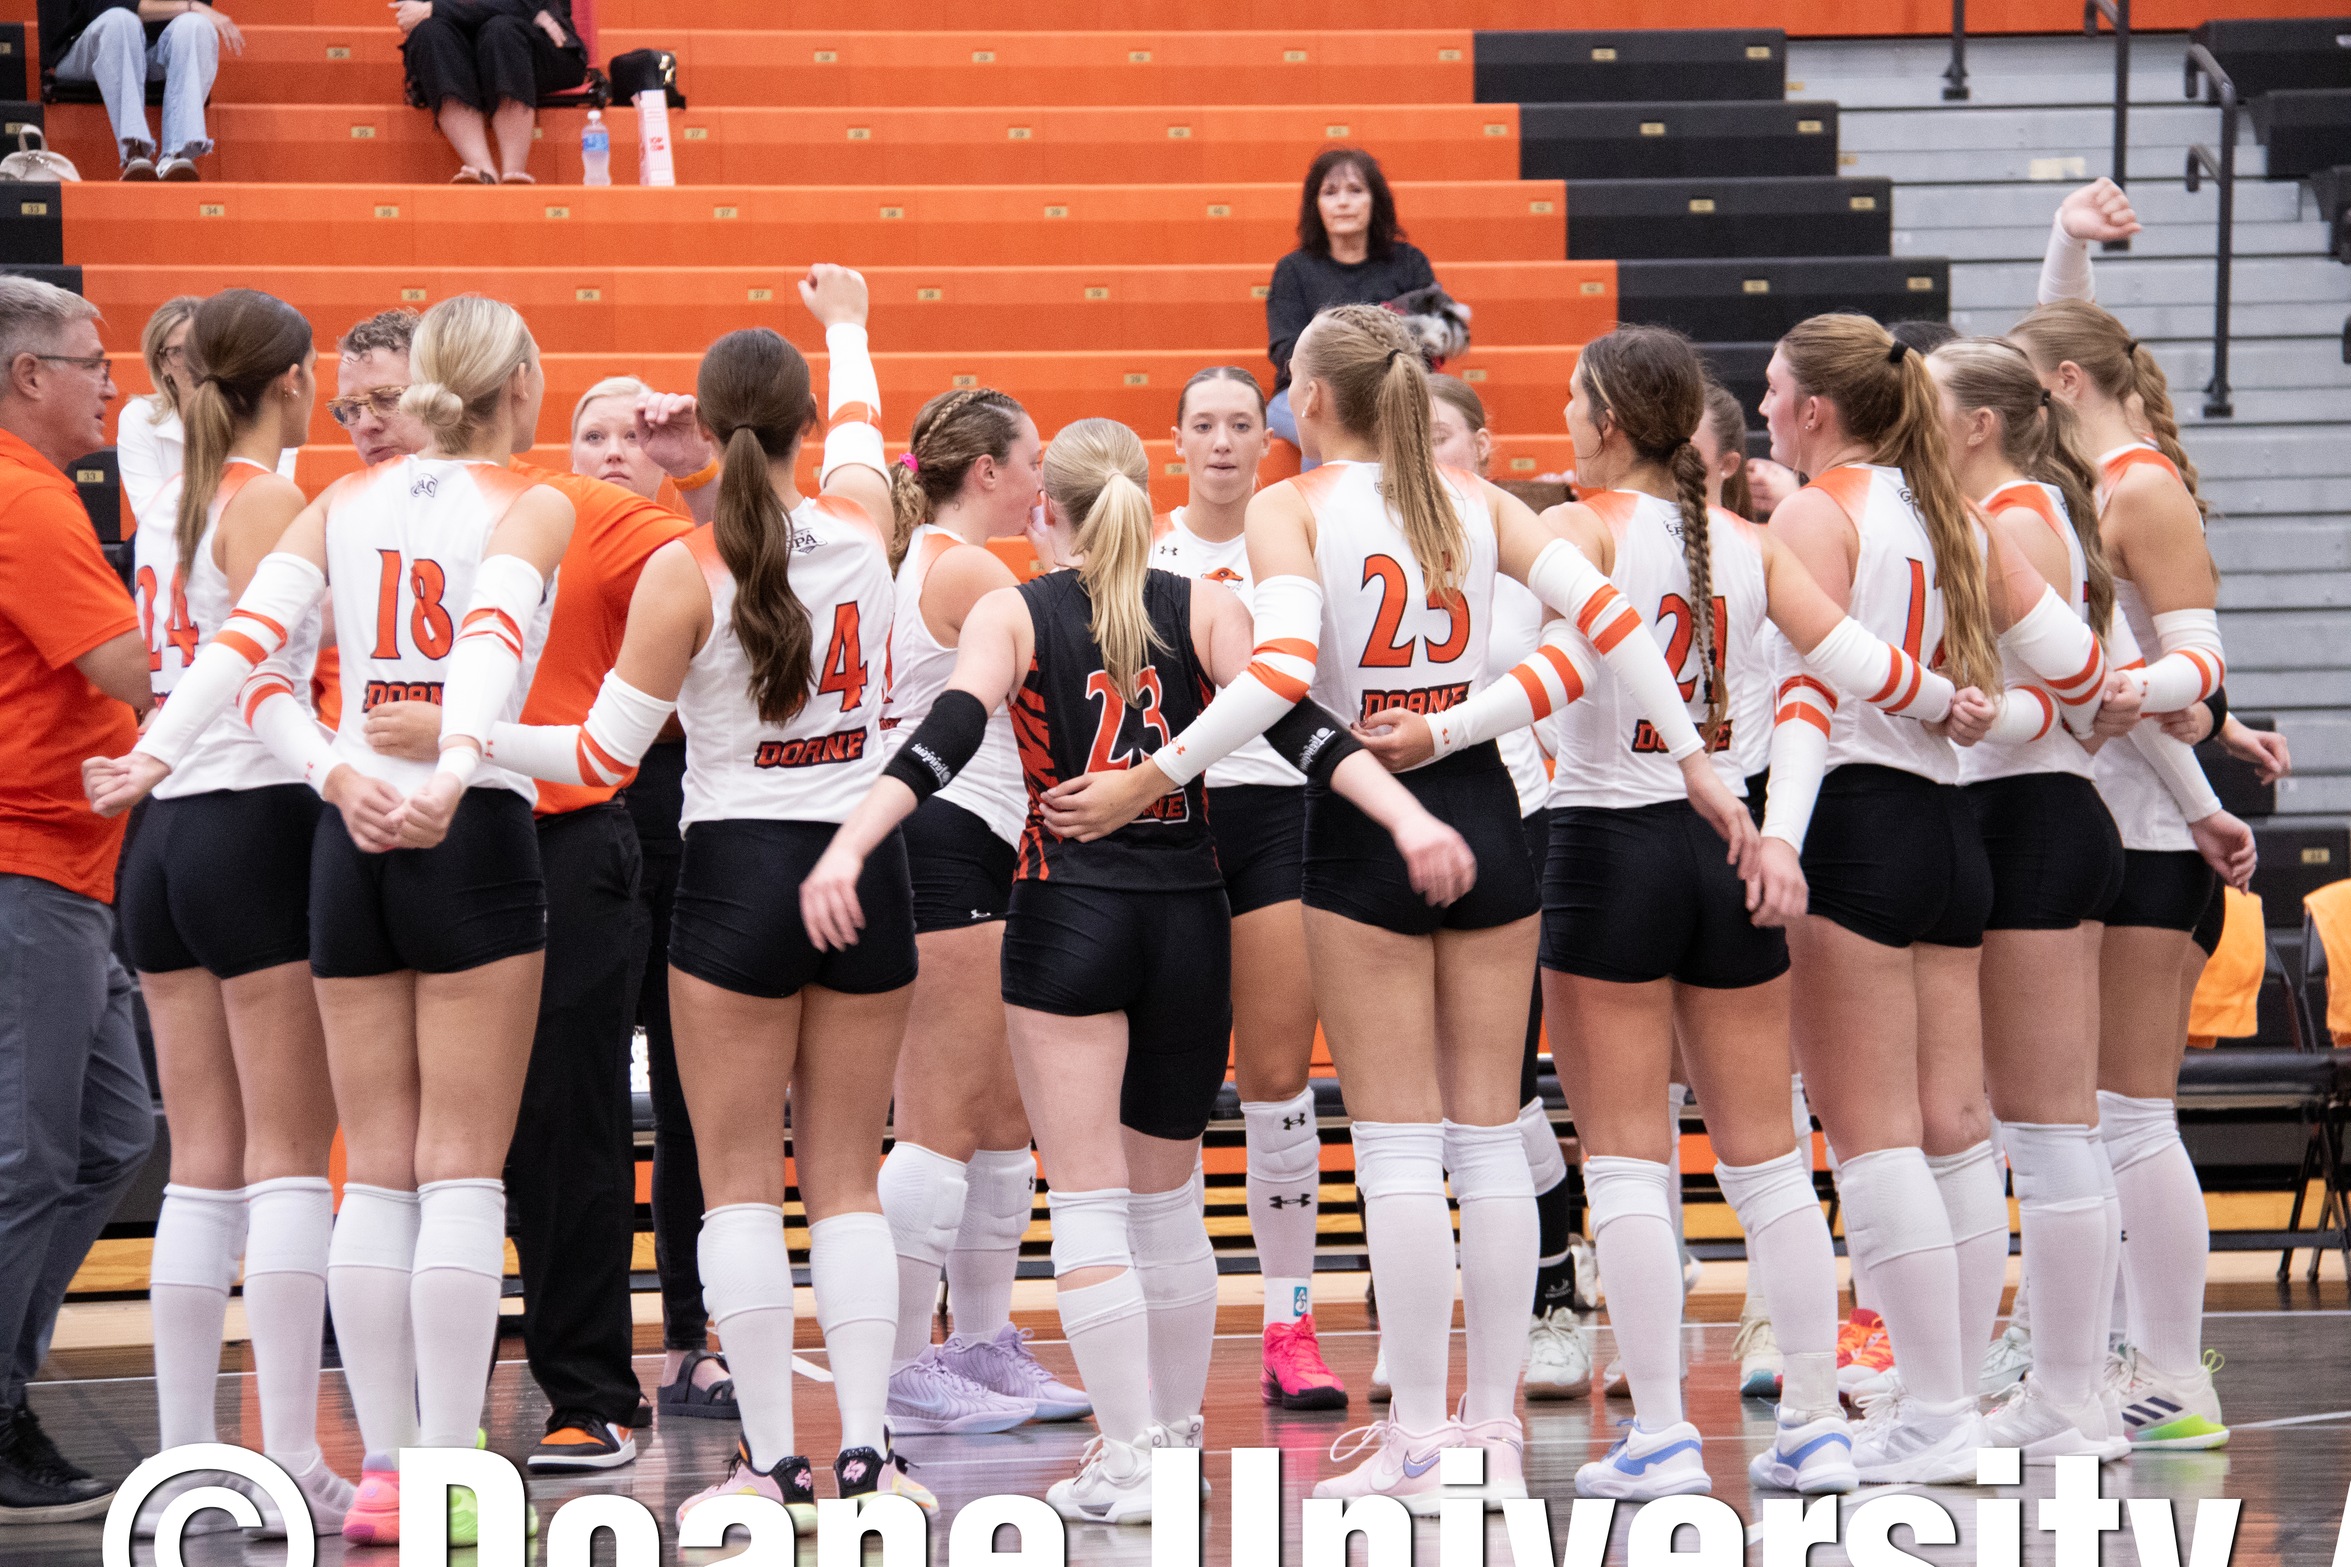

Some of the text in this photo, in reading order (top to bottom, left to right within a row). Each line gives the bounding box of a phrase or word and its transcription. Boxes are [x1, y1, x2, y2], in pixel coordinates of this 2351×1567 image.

[136, 565, 199, 672] 24
[370, 548, 454, 660] 18
[1359, 553, 1470, 668] 25
[1655, 593, 1729, 704] 21
[754, 726, 868, 769] DOANE
[1085, 665, 1171, 774] 23
